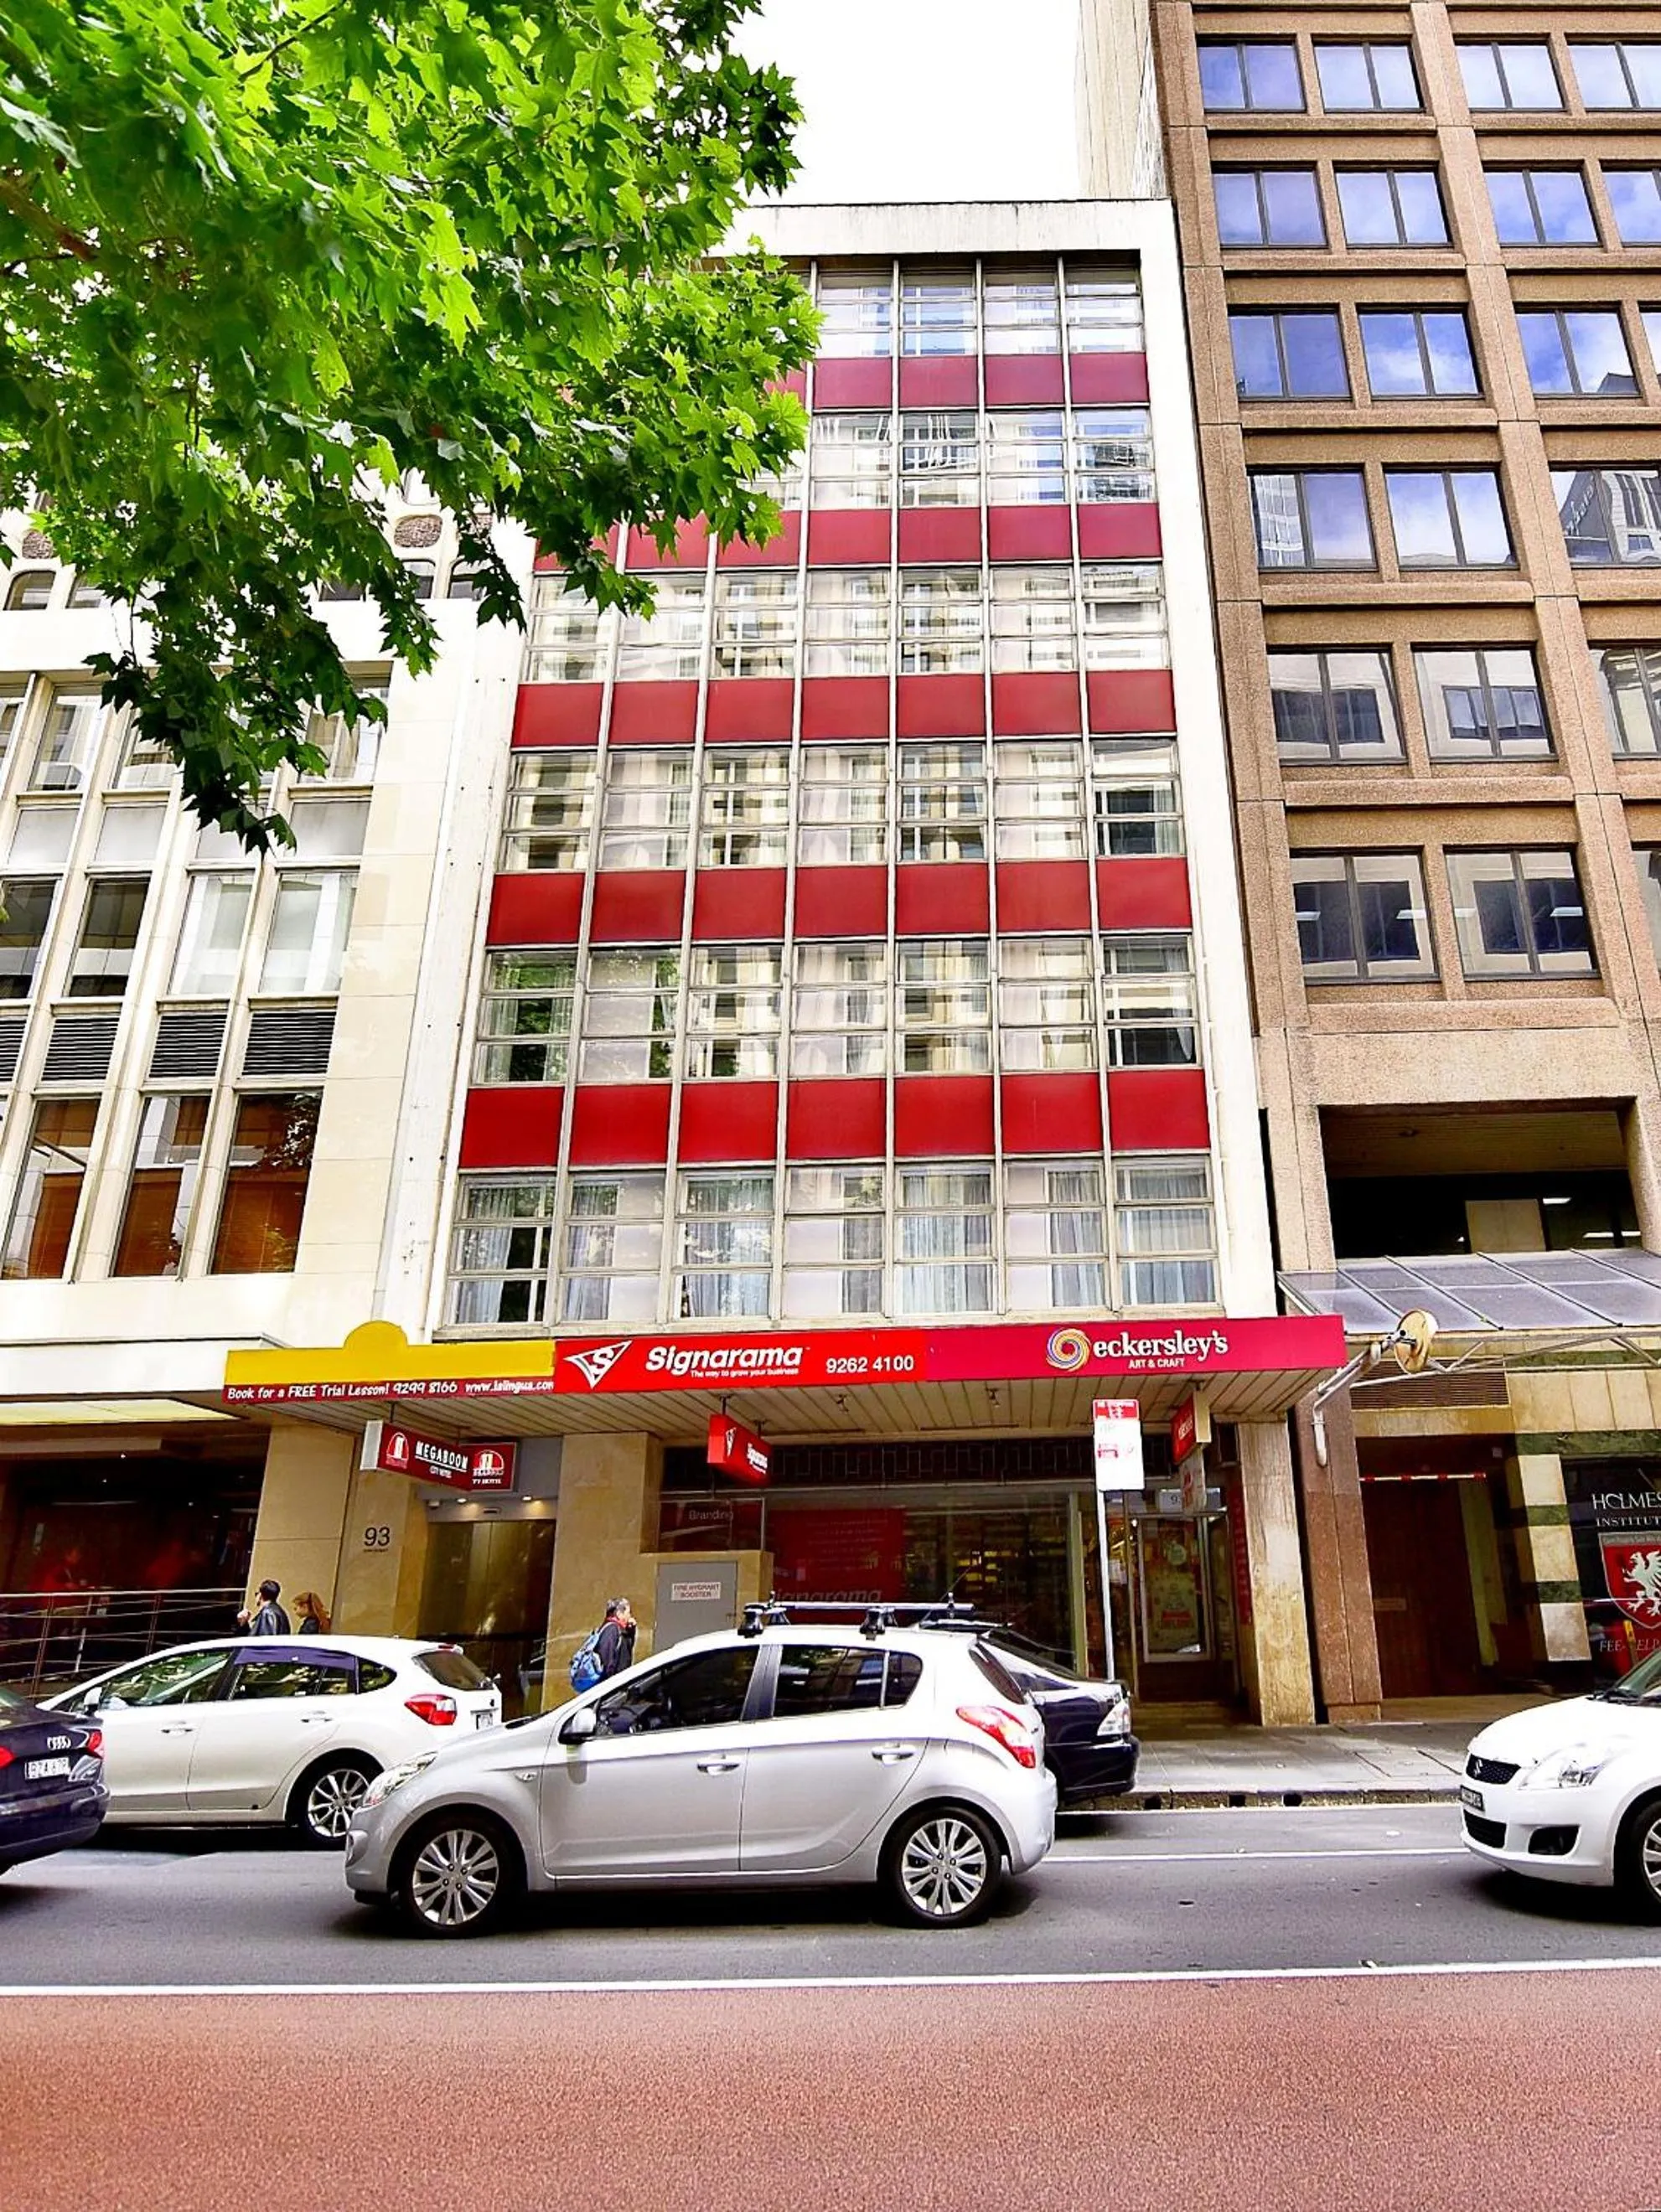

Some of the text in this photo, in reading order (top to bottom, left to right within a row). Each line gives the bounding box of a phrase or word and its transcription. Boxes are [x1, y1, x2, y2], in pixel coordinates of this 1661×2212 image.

[1093, 1330, 1229, 1362] eckersley's
[645, 1346, 803, 1376] Signarama
[825, 1355, 914, 1373] 9262 4100
[1128, 1357, 1185, 1369] ART & CRAFT
[691, 1369, 704, 1378] The
[721, 1369, 729, 1377] to
[730, 1369, 749, 1378] grow
[750, 1368, 766, 1378] your
[227, 1387, 254, 1399] Book
[258, 1387, 275, 1398] for
[277, 1389, 284, 1398] a
[287, 1385, 317, 1398] FREE
[320, 1383, 345, 1396] Trial
[348, 1382, 390, 1397] Lesson!
[392, 1382, 426, 1394] 9299
[428, 1381, 458, 1394] 8166
[416, 1440, 468, 1470] MEGABOOM
[688, 1509, 734, 1522] Branding
[364, 1526, 391, 1547] 93
